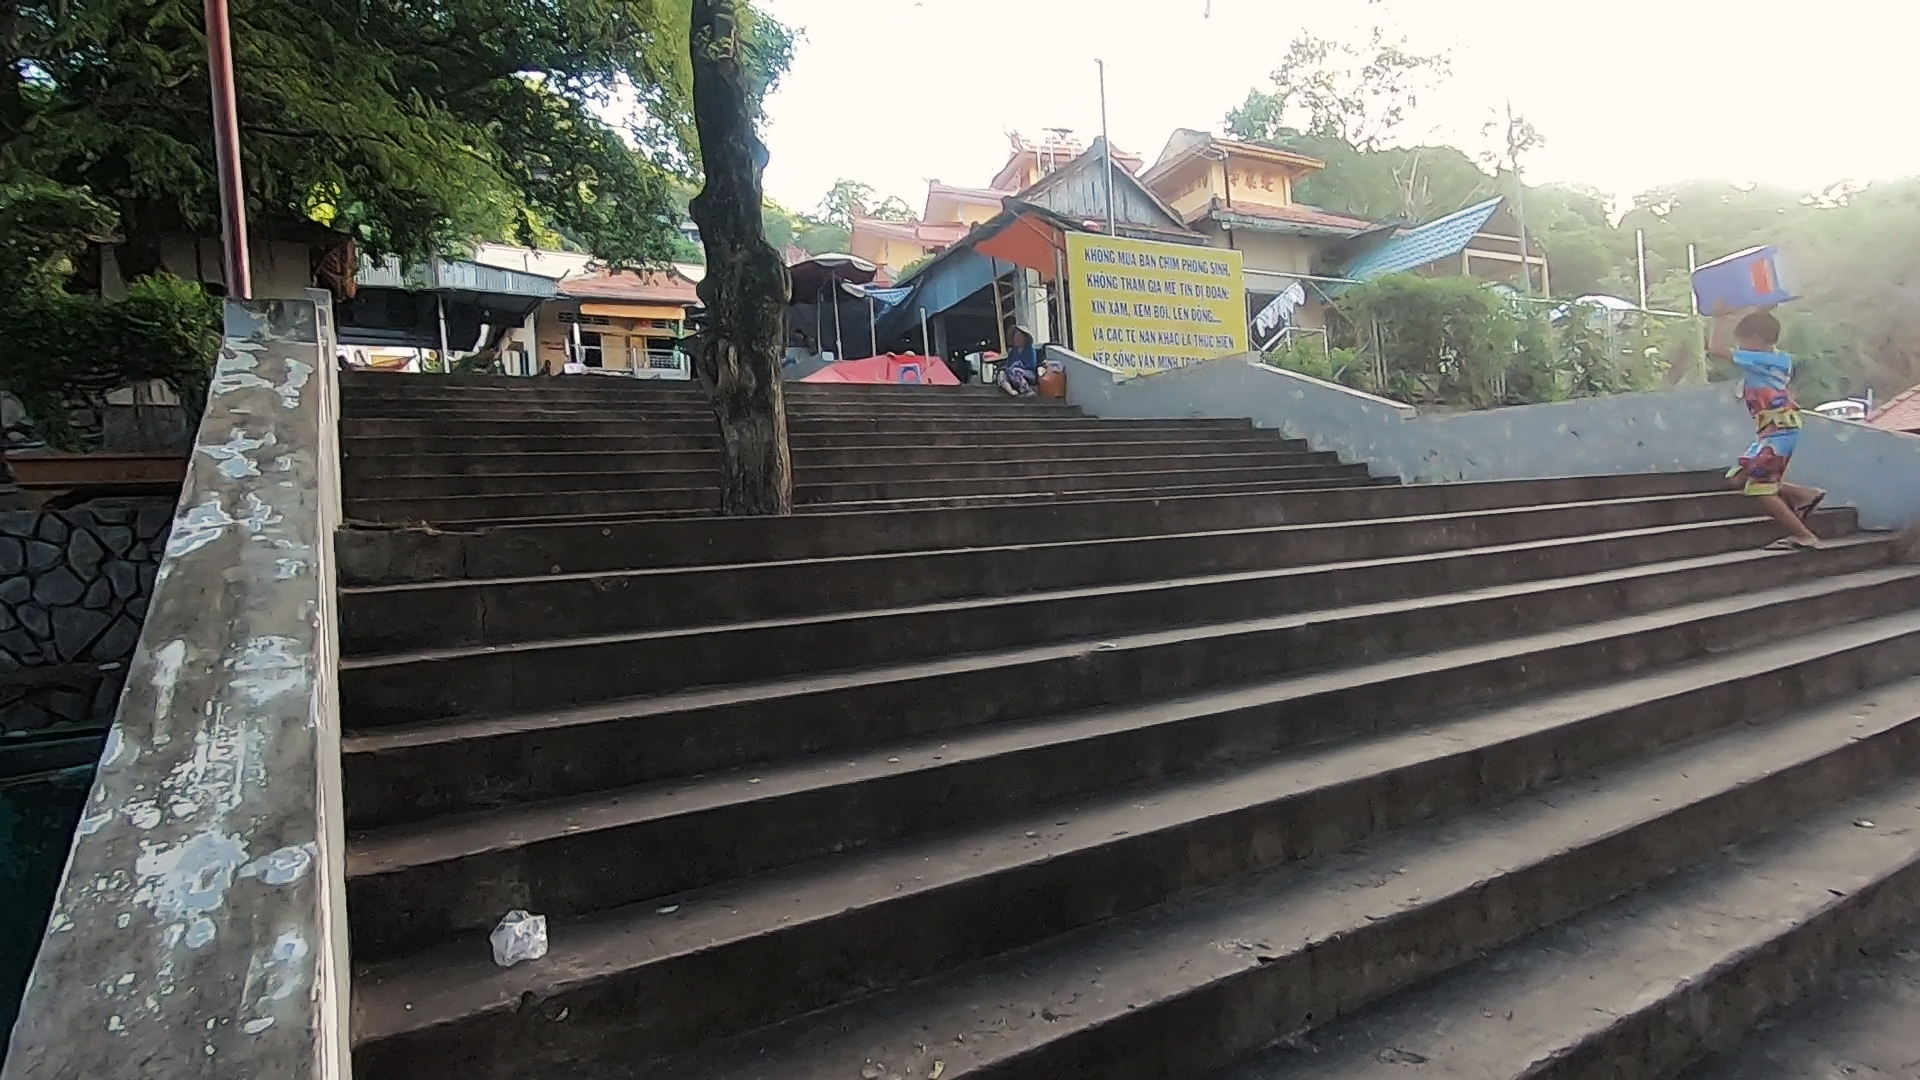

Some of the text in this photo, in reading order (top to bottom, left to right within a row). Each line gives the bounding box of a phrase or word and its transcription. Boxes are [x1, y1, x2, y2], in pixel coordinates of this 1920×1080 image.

[1118, 252, 1136, 266] MUA
[1159, 256, 1179, 270] CHIM
[1121, 277, 1145, 292] THAM
[1148, 280, 1162, 293] GIA
[1133, 303, 1151, 317] XEM
